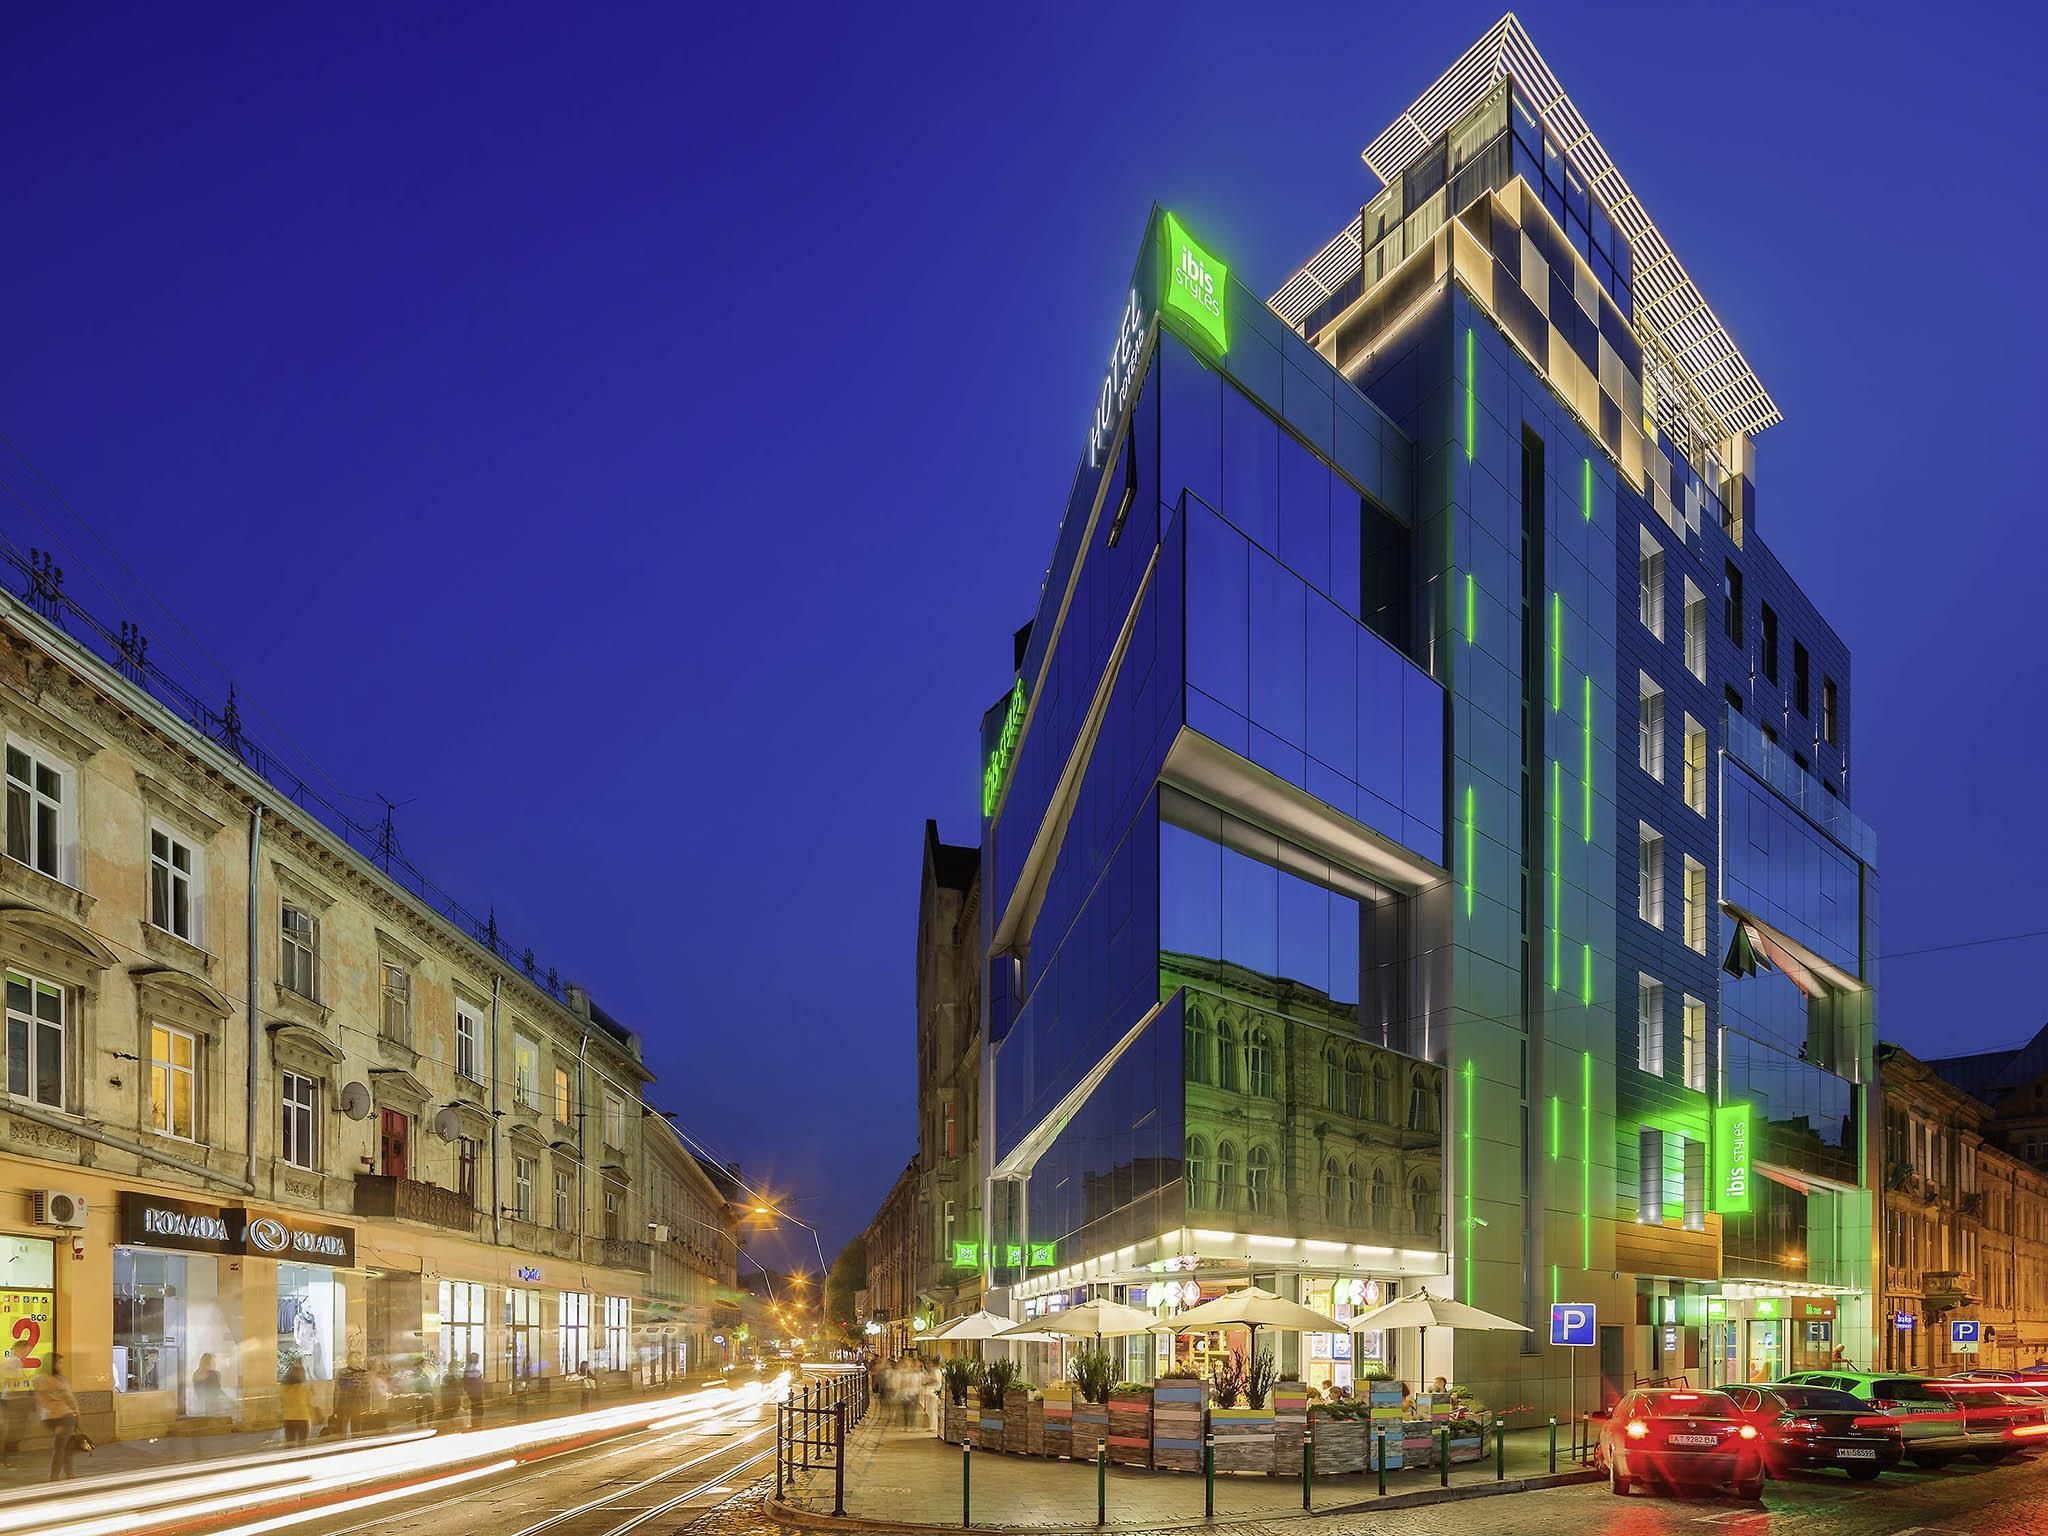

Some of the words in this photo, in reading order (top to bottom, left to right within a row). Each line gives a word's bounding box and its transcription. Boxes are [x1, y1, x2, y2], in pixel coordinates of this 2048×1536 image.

[1183, 246, 1213, 295] ibis
[1091, 288, 1140, 468] HOTEL
[1727, 1167, 1744, 1196] ibis
[12, 1317, 42, 1369] 2
[1563, 1310, 1586, 1340] P
[1959, 1324, 1974, 1340] P
